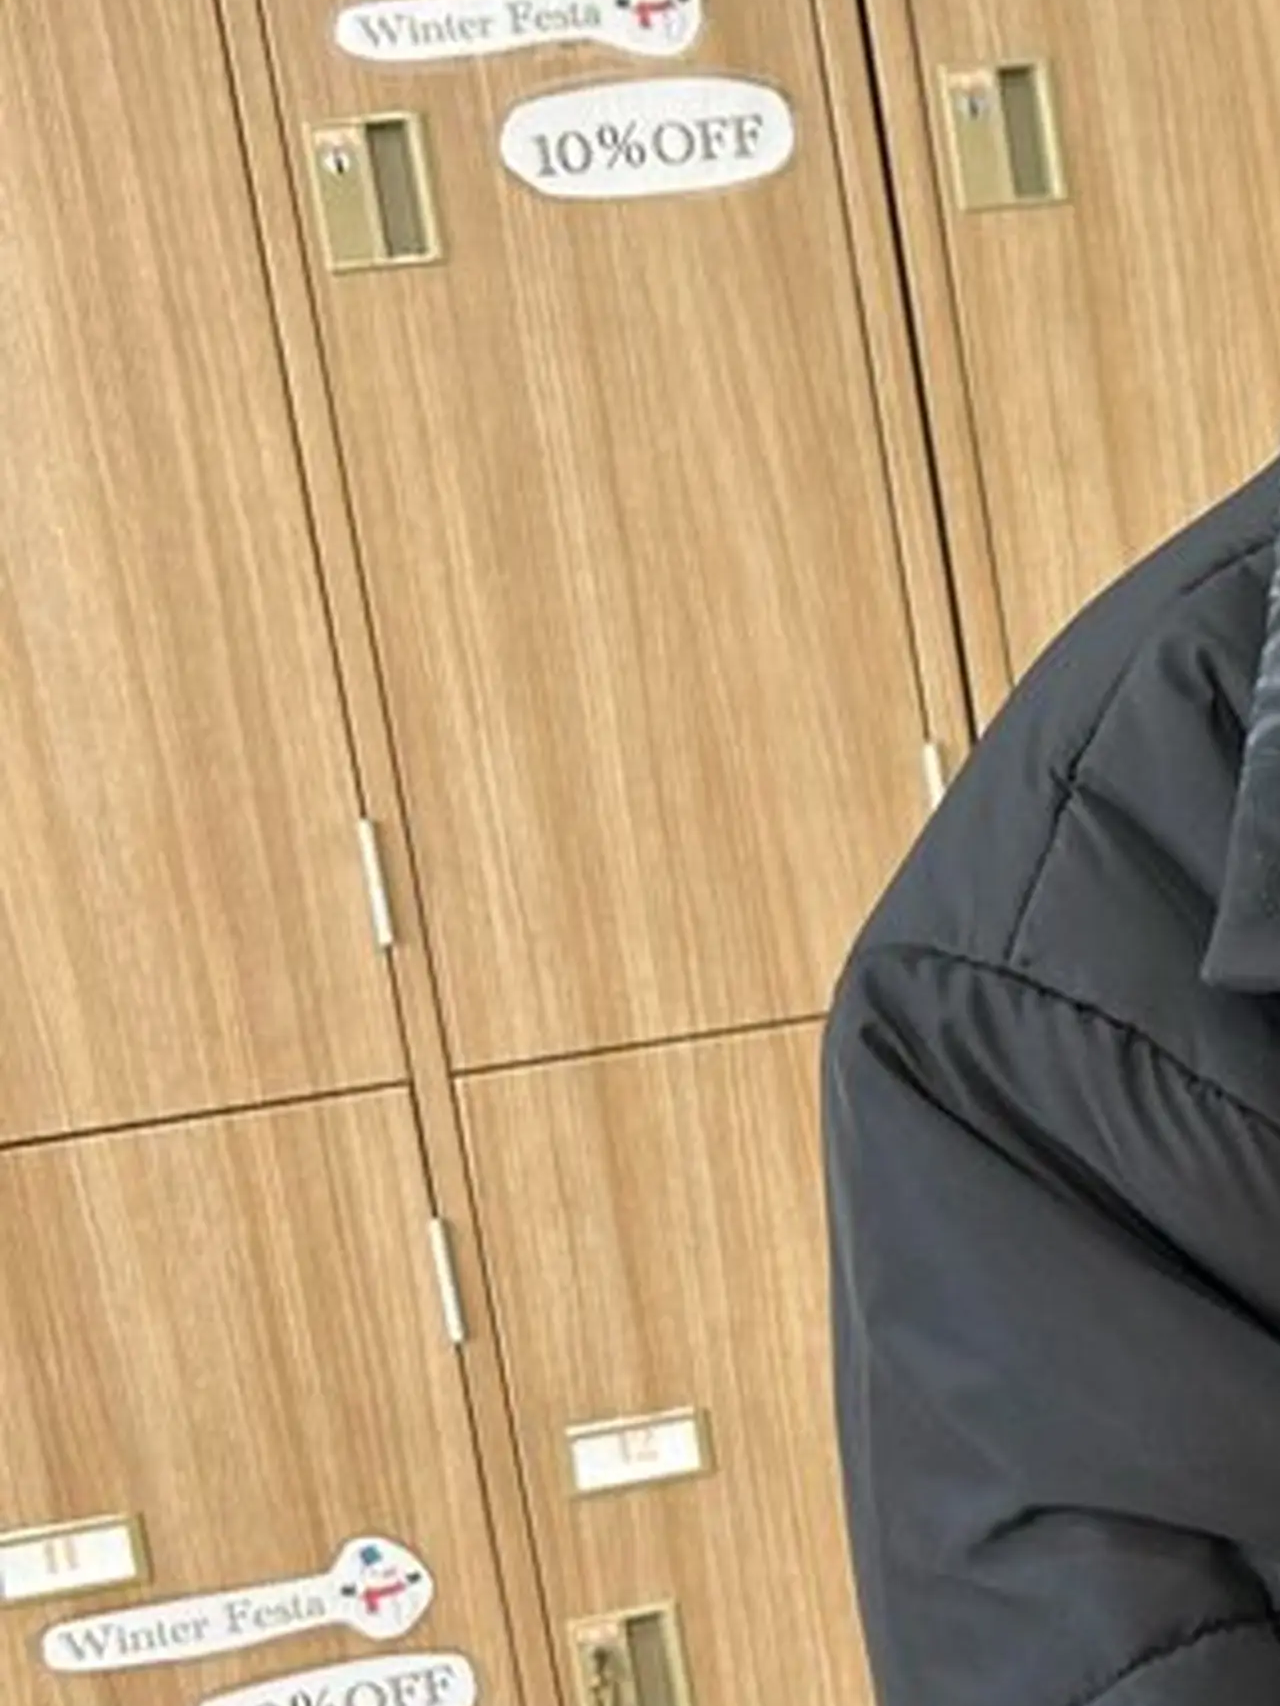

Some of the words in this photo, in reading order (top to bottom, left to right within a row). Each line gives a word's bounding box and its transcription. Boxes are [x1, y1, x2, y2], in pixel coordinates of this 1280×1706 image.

[356, 13, 494, 48] Winter
[506, 0, 601, 35] Festa
[530, 112, 764, 177] 10%OFF
[59, 1621, 211, 1662] Winter
[222, 1594, 327, 1635] Festa
